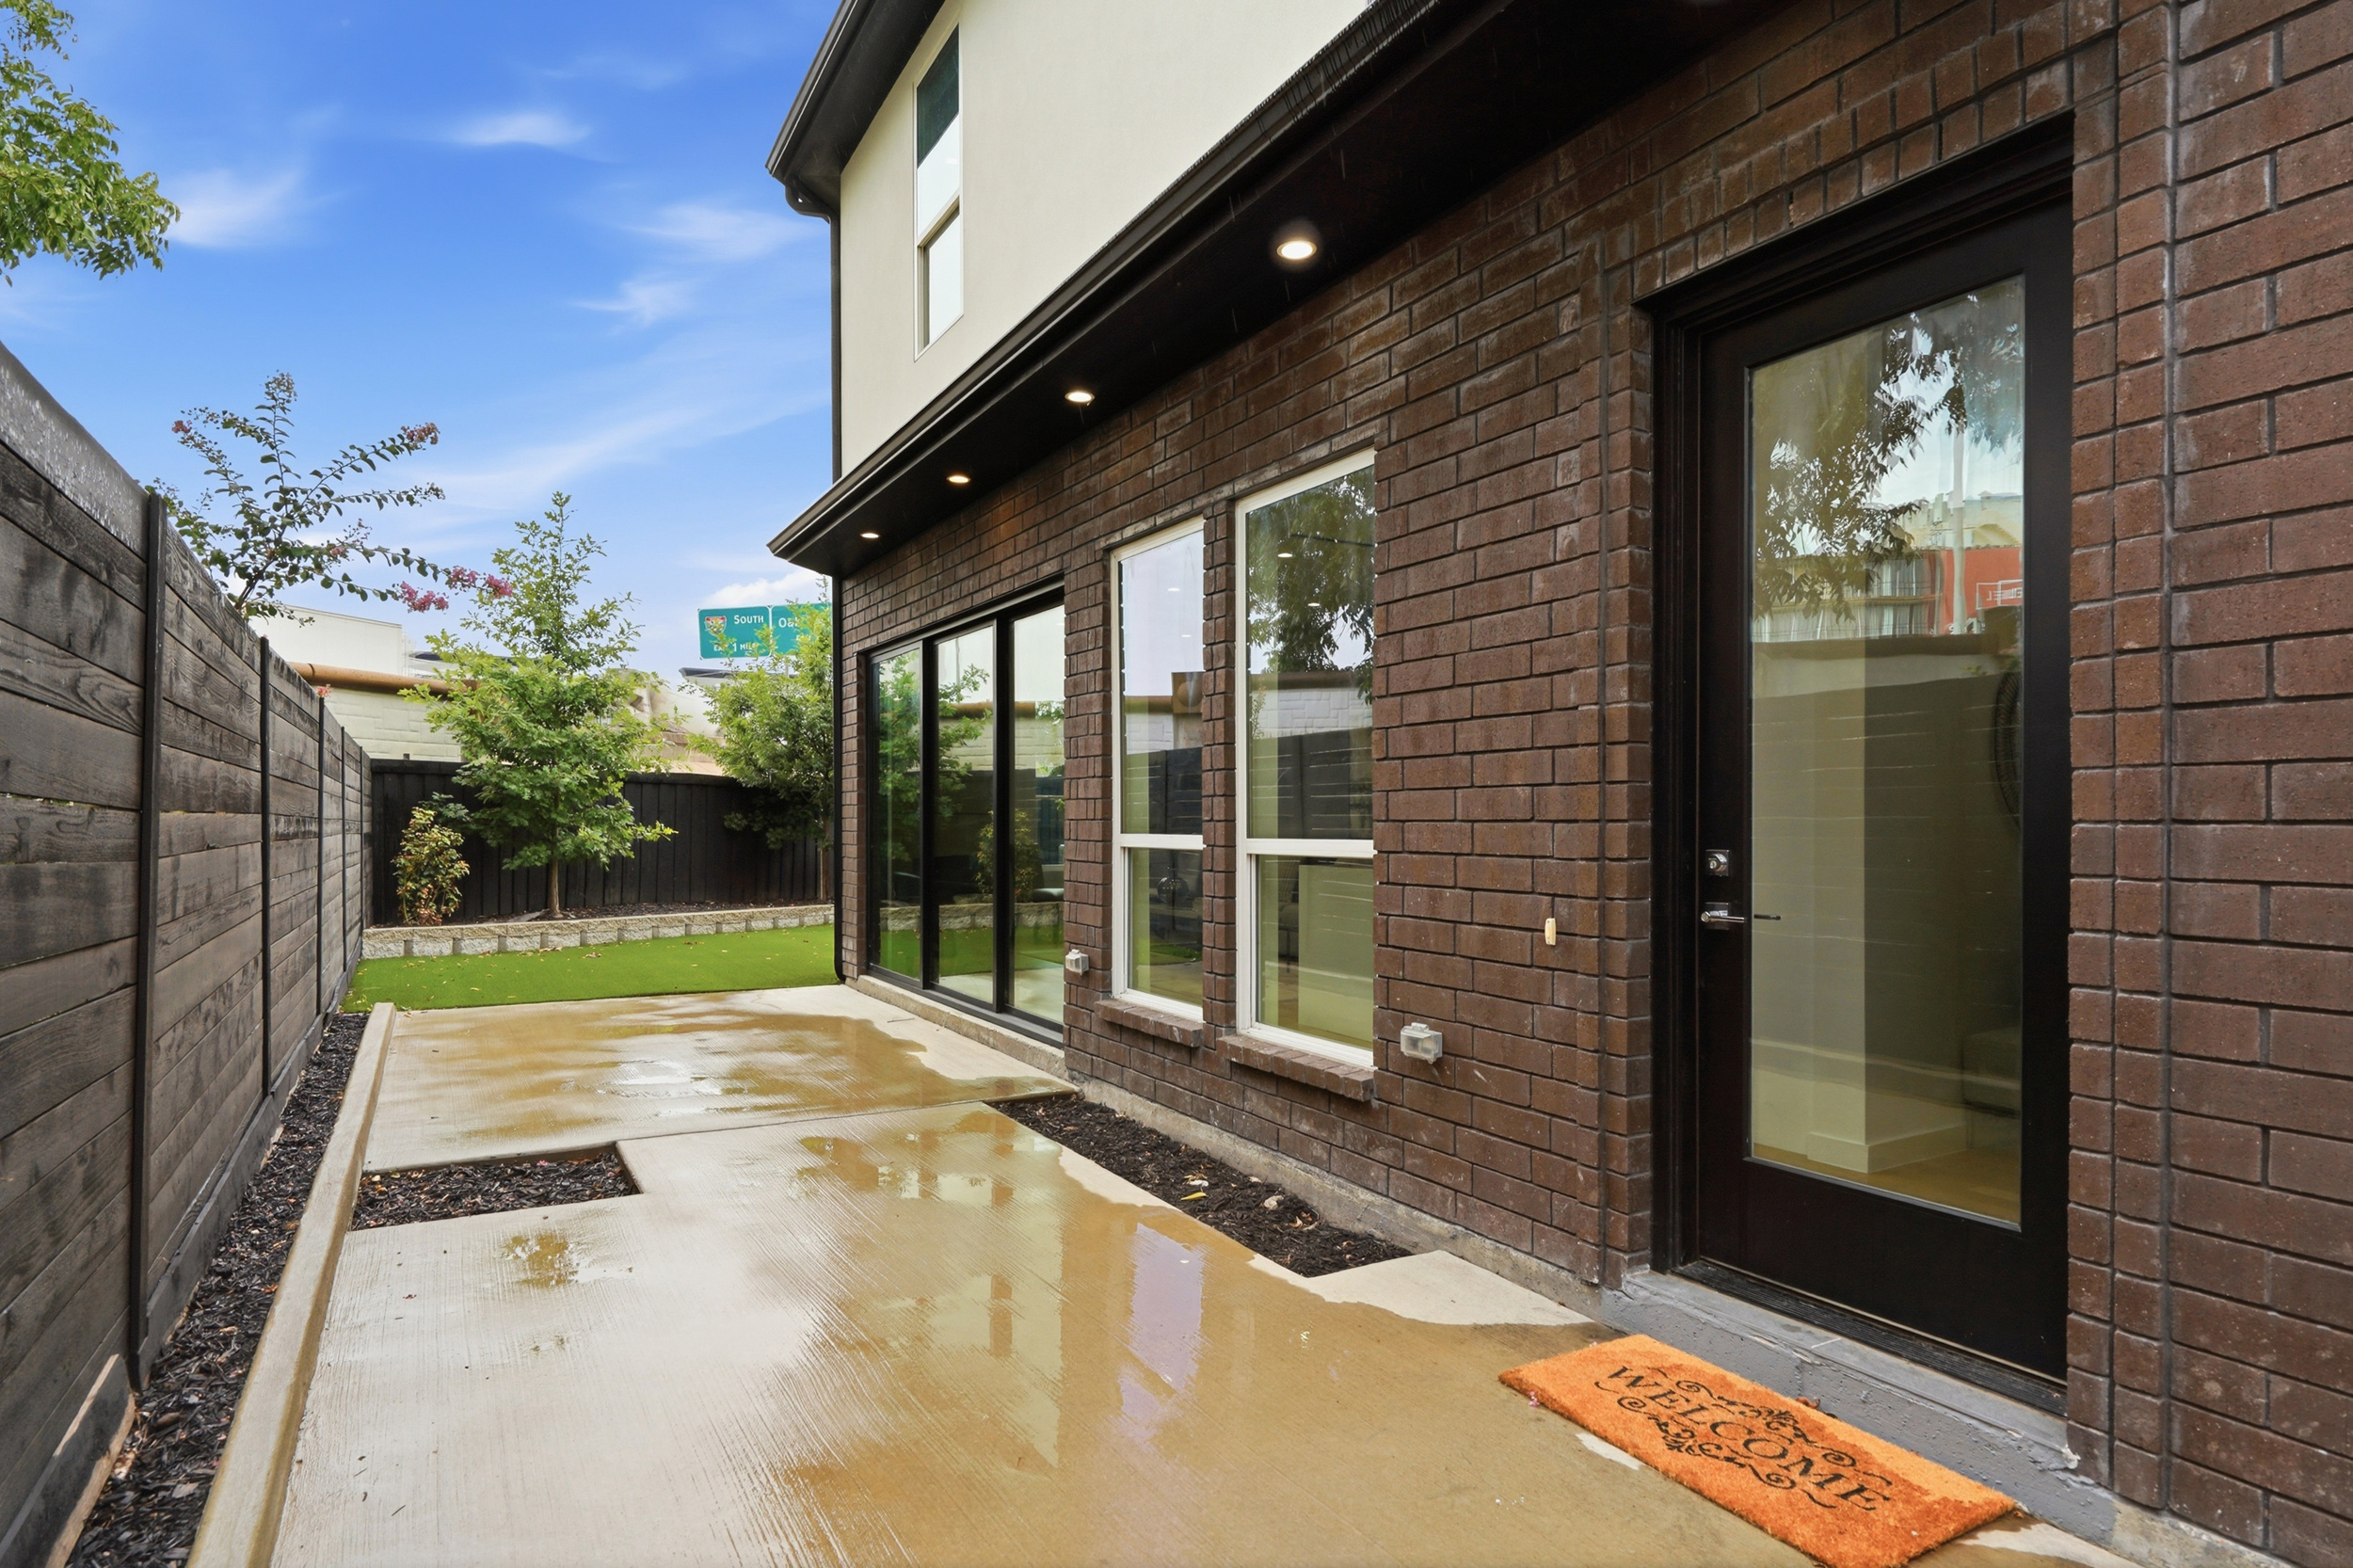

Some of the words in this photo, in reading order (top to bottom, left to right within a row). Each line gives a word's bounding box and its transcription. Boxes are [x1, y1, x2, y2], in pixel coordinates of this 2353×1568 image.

[734, 615, 764, 625] SOUTH
[732, 642, 737, 652] 1
[1606, 1365, 1892, 1511] WELCOME
